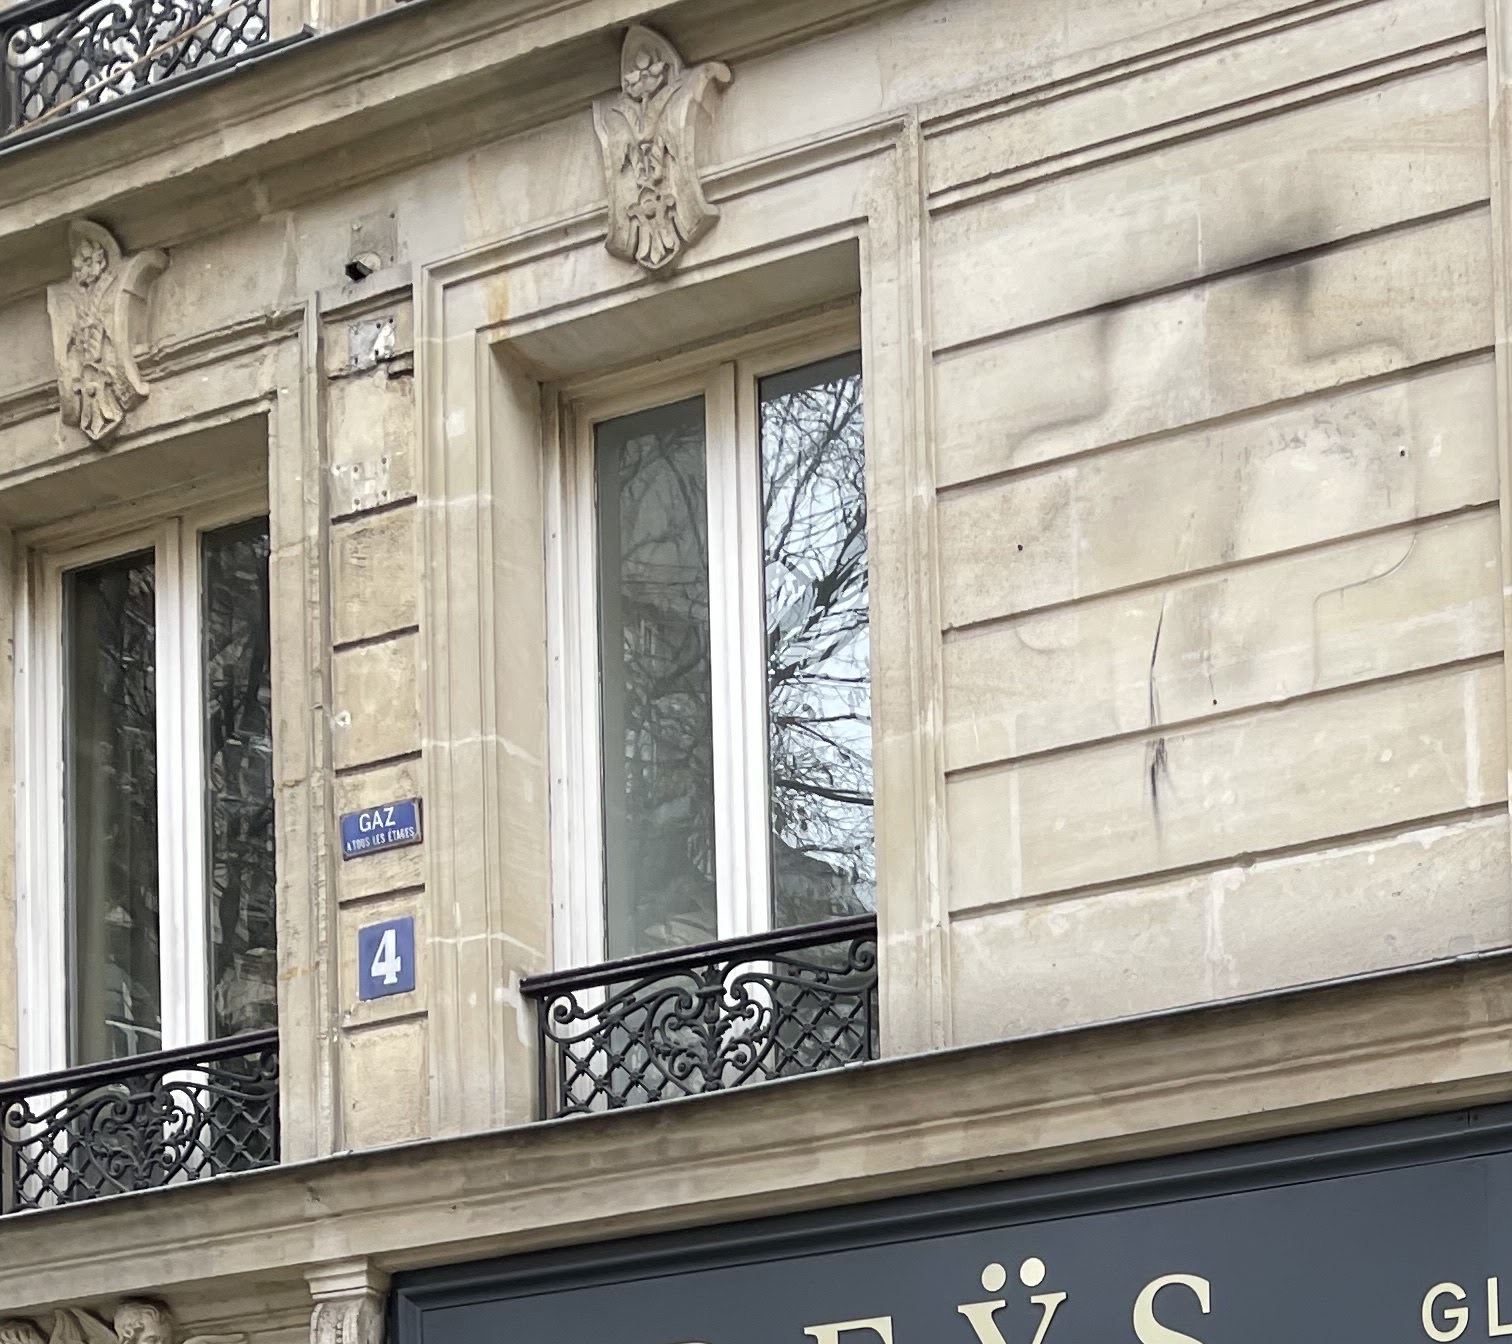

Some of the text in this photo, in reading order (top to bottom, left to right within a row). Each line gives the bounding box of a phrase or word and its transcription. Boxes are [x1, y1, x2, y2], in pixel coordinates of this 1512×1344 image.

[359, 806, 396, 832] GAZ
[352, 836, 370, 850] TOUS
[372, 833, 386, 845] LES
[371, 929, 402, 985] 4
